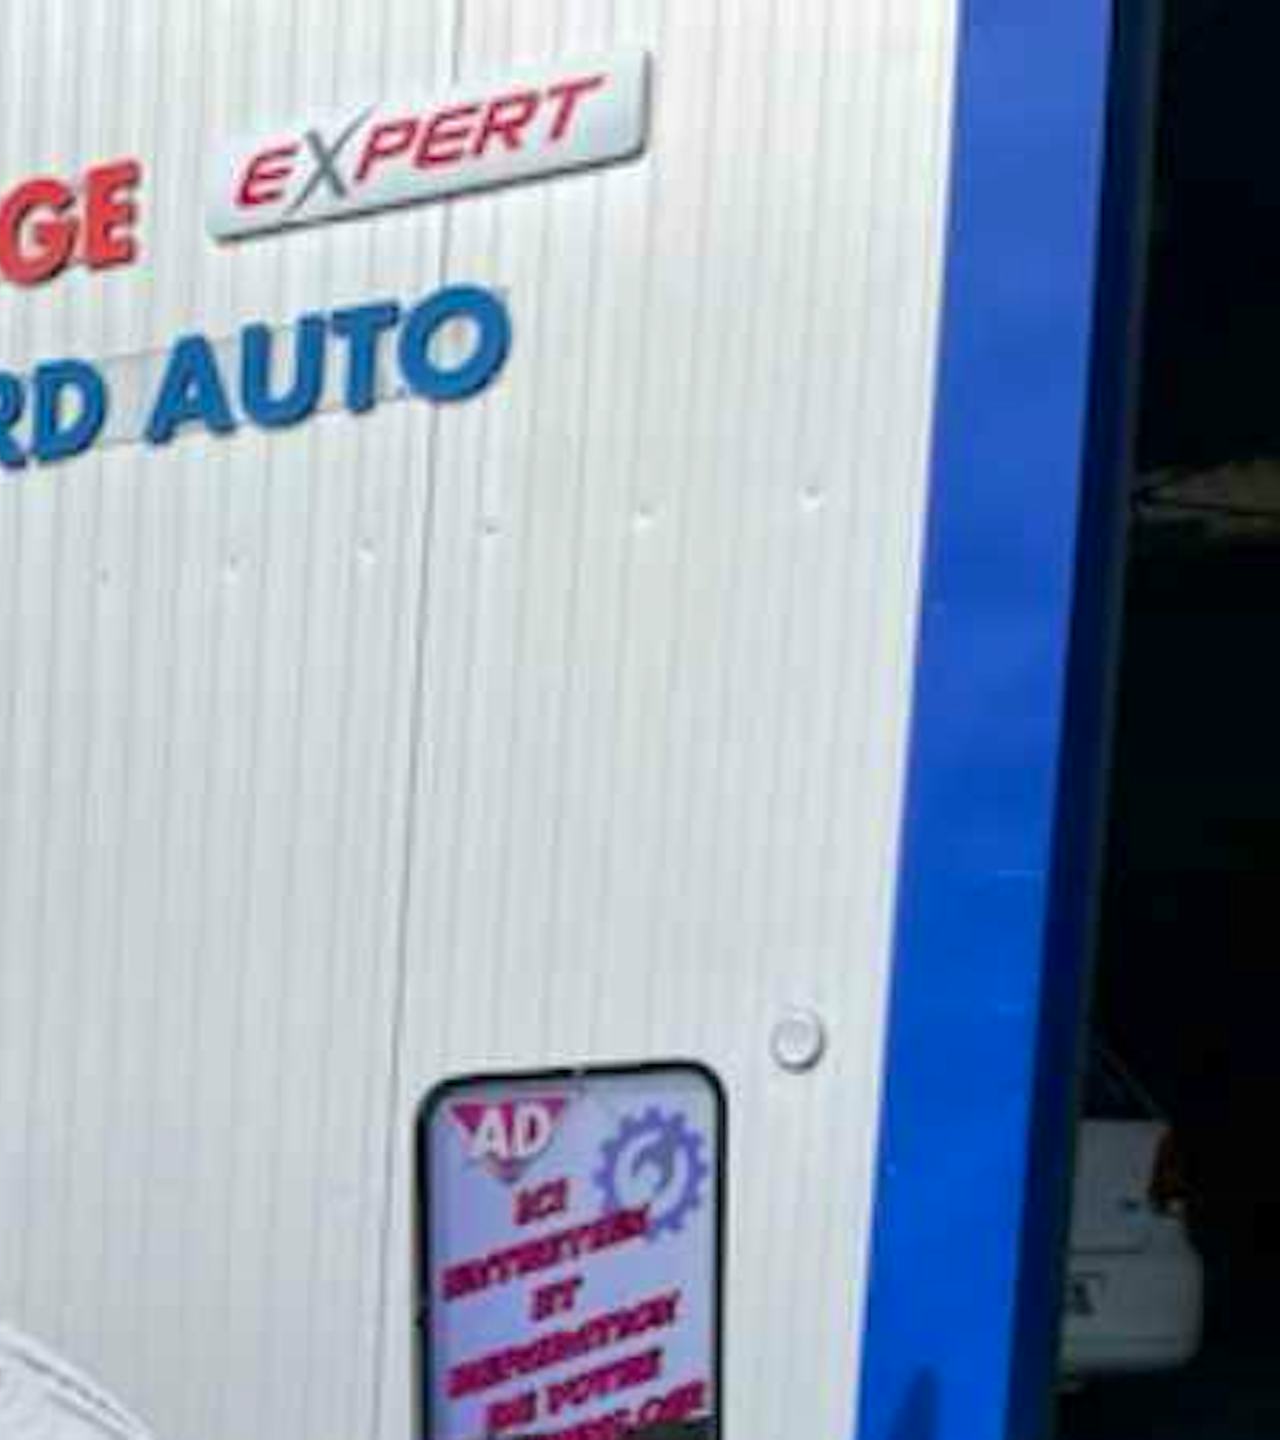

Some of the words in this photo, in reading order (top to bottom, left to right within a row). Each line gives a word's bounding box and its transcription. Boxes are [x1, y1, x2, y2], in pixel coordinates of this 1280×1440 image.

[234, 73, 608, 214] EXPERT
[145, 283, 512, 445] AUTO
[467, 1104, 552, 1159] AD
